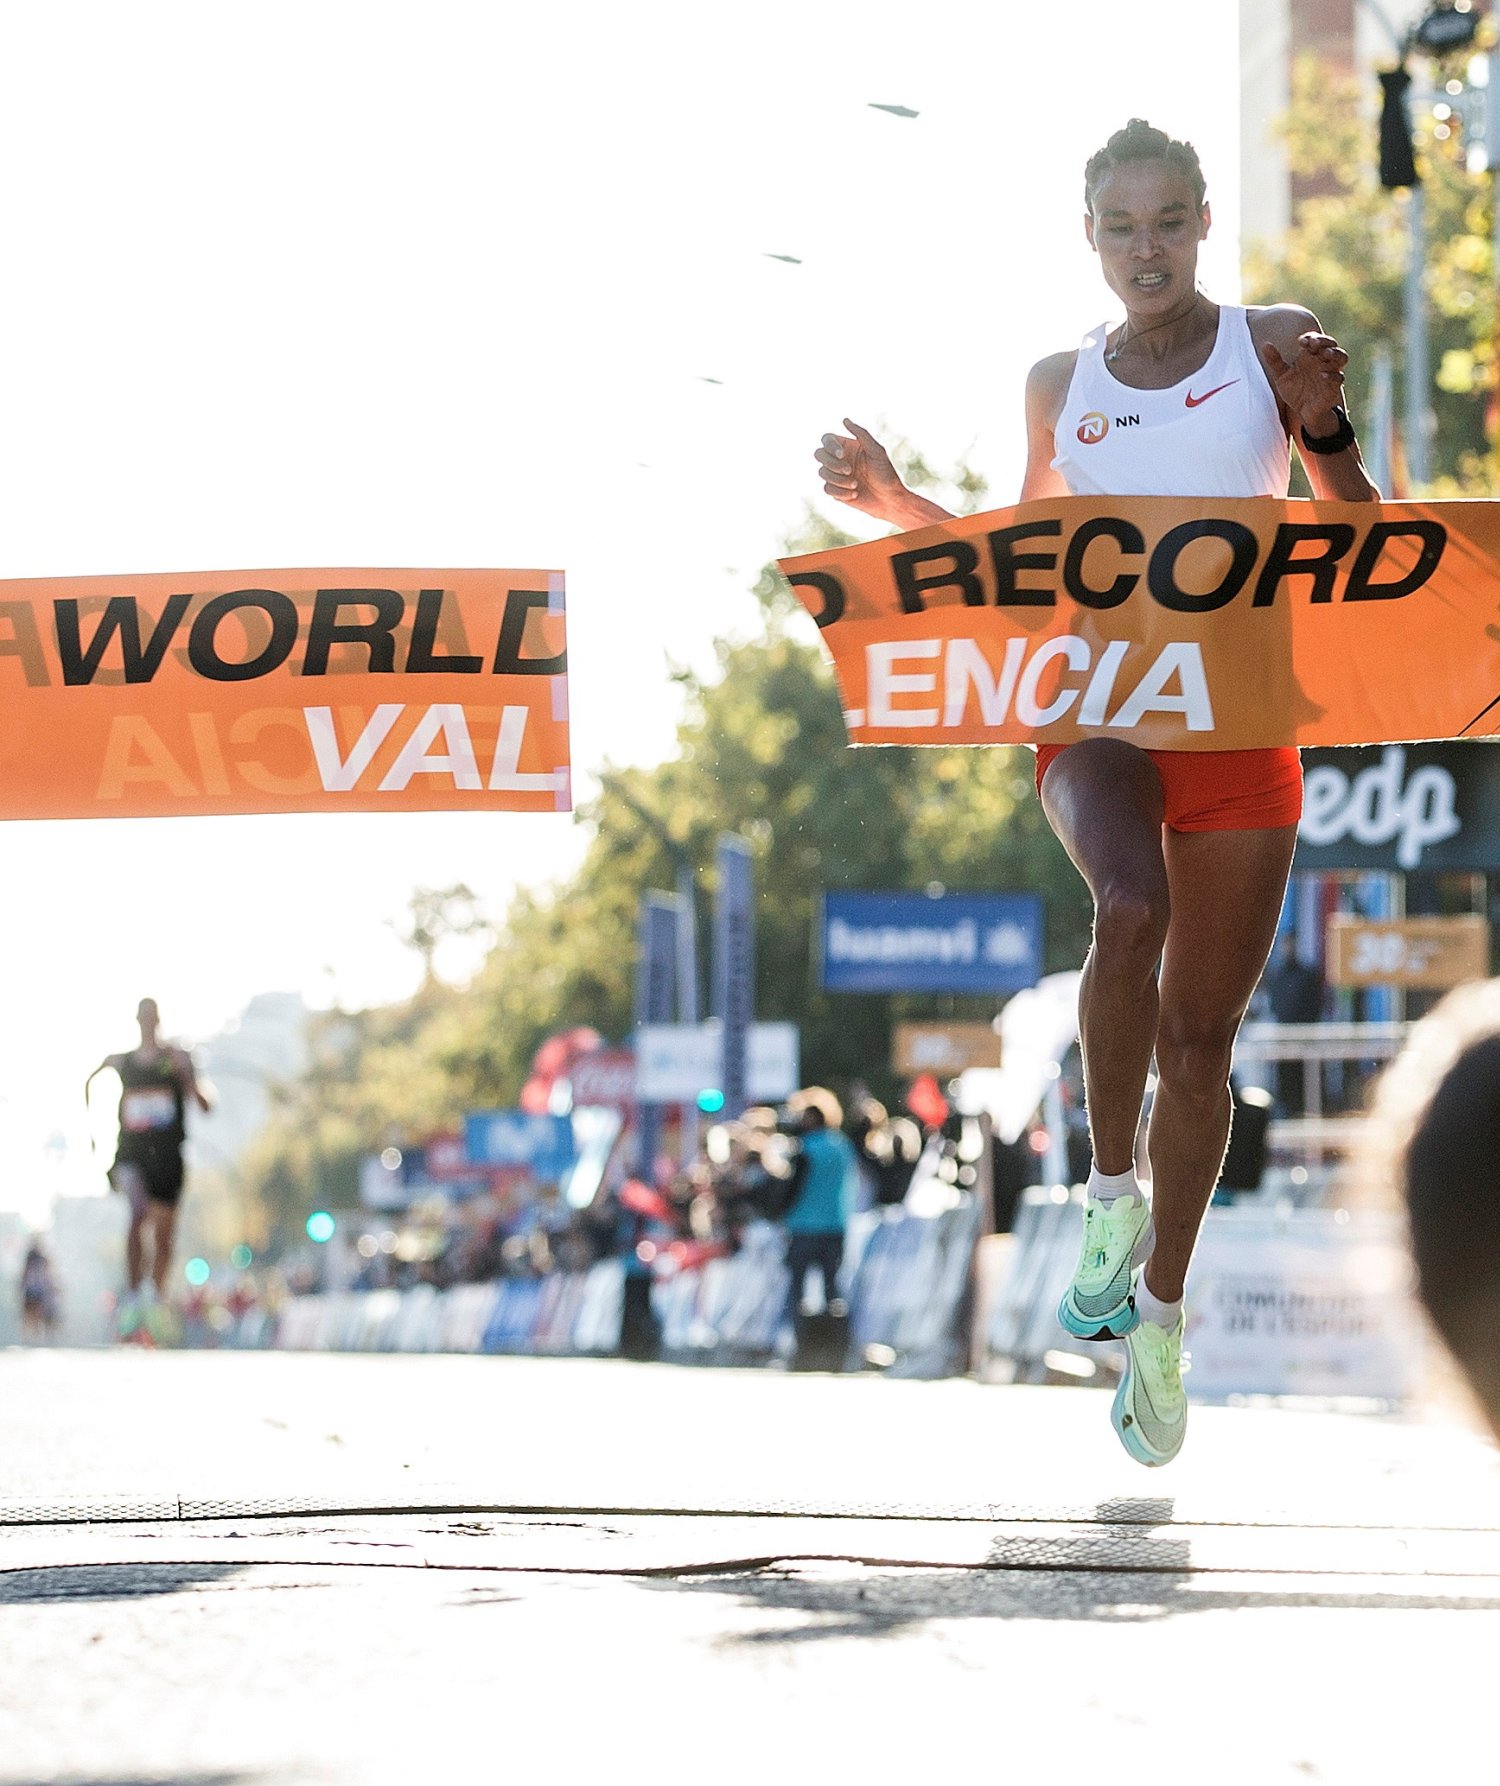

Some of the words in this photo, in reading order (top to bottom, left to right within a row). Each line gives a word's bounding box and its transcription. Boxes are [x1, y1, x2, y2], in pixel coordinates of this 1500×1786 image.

[1115, 414, 1141, 428] NN
[890, 516, 1447, 614] RECORD
[53, 588, 568, 687] WORLD
[303, 703, 568, 792] VAL
[1299, 745, 1461, 869] edp
